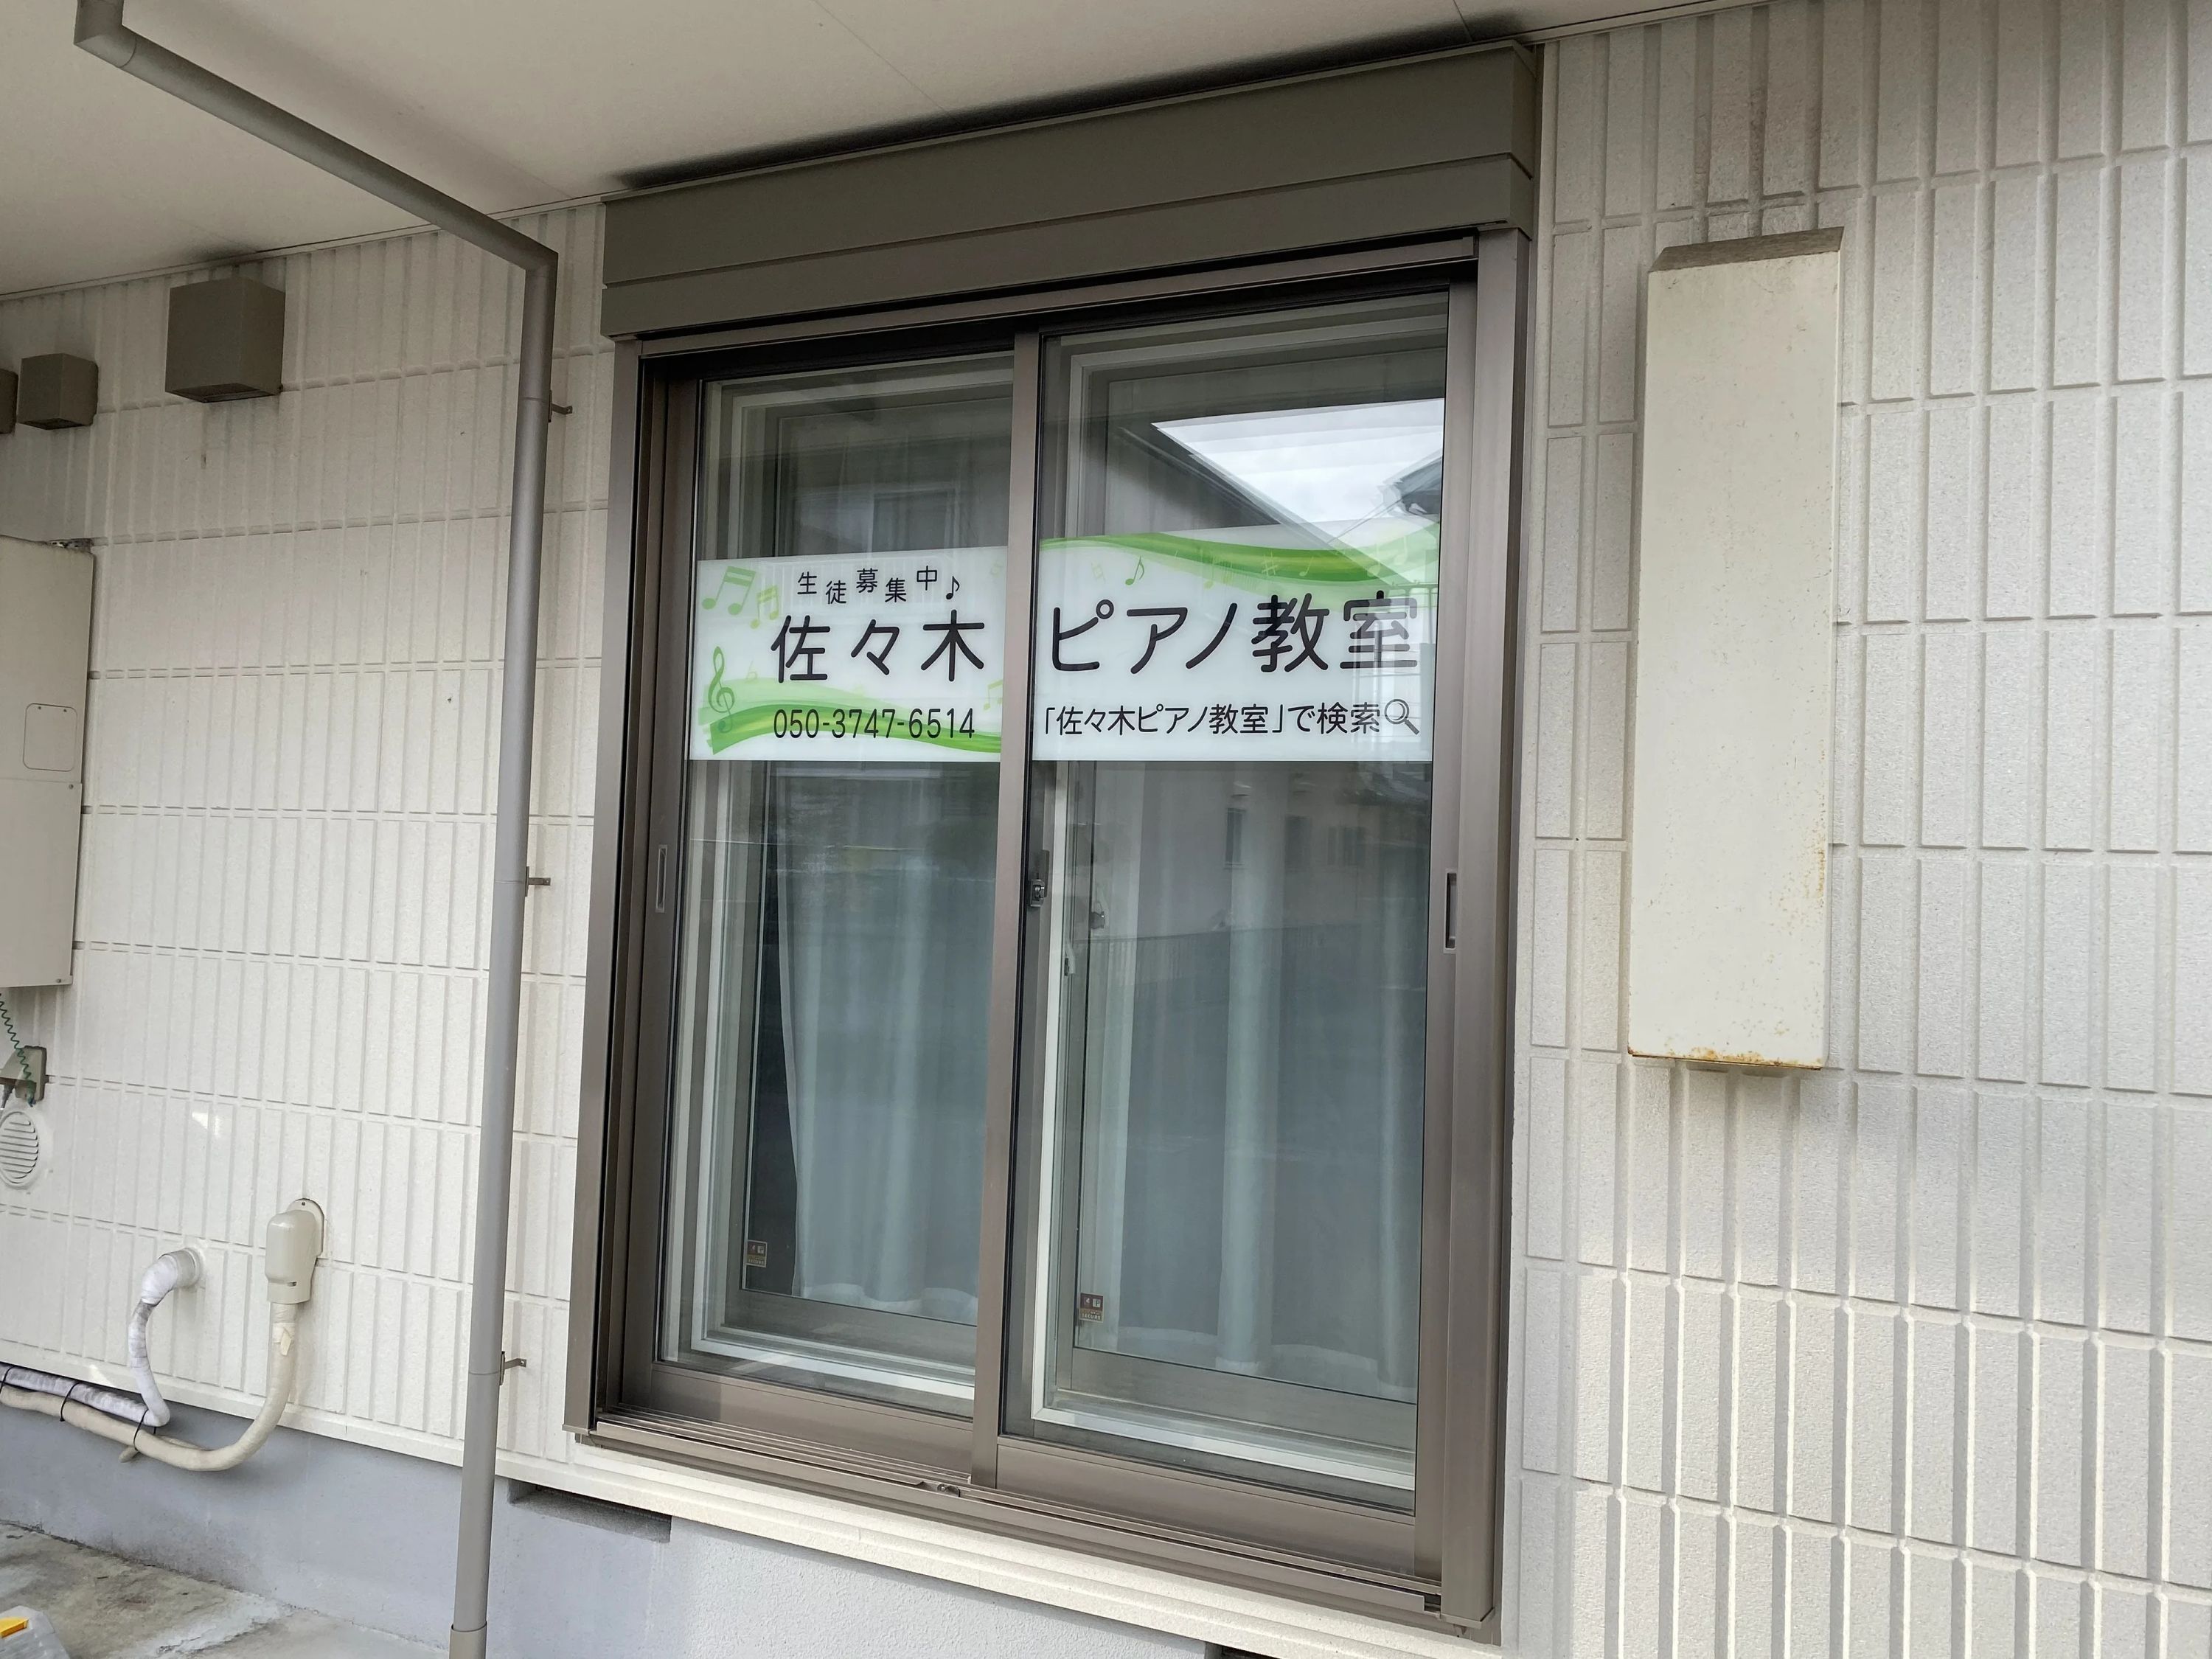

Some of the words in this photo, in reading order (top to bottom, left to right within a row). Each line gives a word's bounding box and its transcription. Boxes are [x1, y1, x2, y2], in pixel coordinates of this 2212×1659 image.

[771, 609, 985, 683] 佐々木
[1052, 591, 1418, 673] ピアノ教室
[773, 708, 975, 739] 050-3747-6514
[1045, 701, 1380, 736] 「佐々木ピアノ教室」で検索
